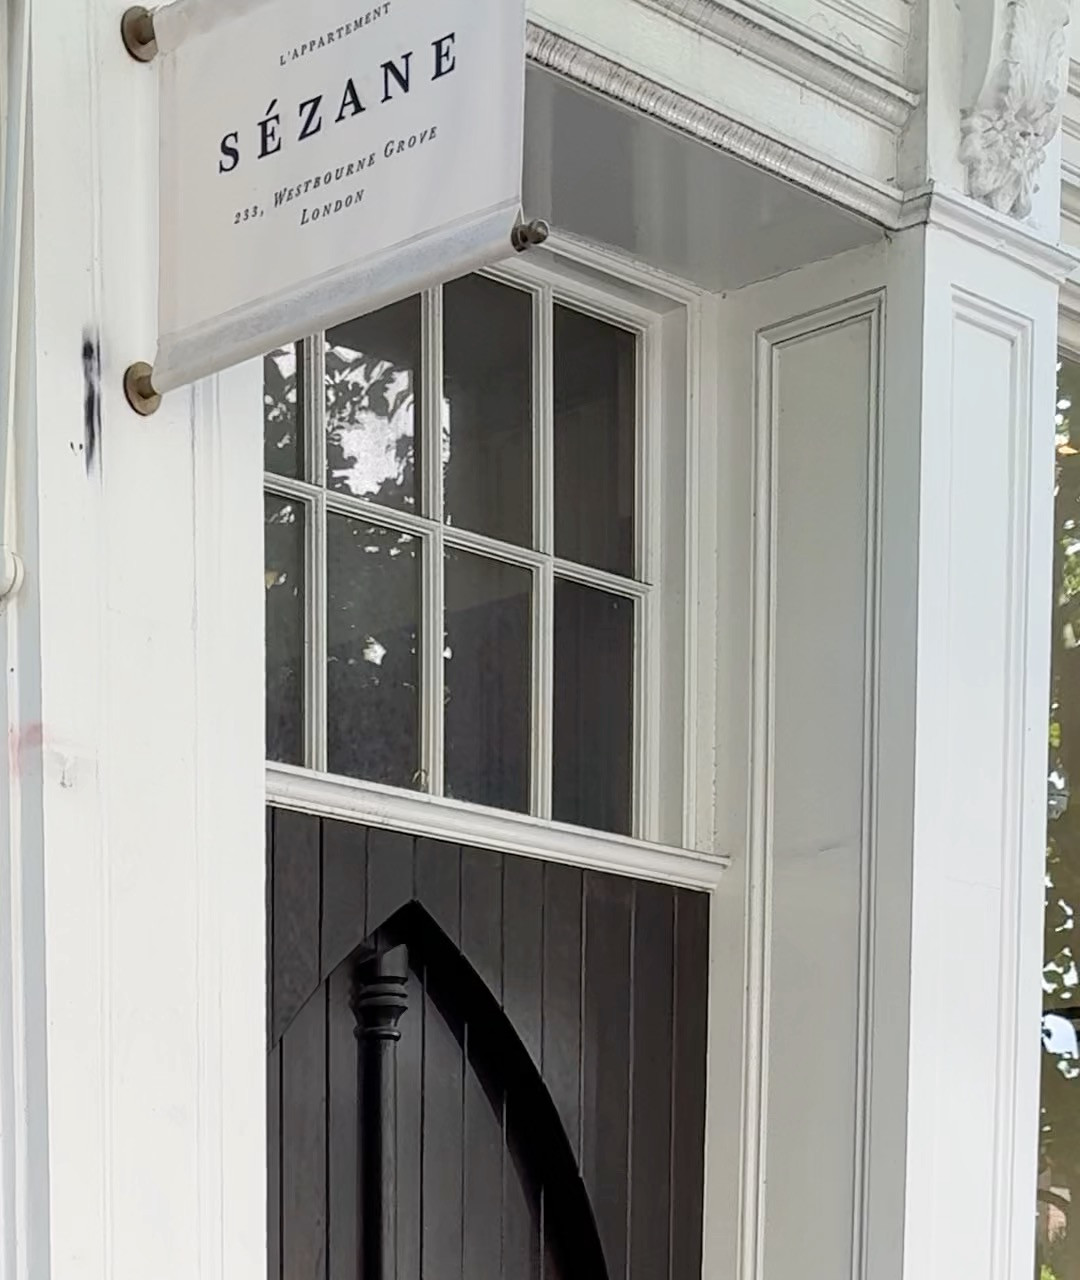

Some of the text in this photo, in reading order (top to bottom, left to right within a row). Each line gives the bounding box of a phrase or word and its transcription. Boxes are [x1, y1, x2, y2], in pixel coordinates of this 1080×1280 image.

[279, 1, 391, 66] L'APPARTEMENT
[218, 31, 457, 174] SÉZANE
[233, 126, 438, 225] 233, WESTBOURNE GROVE
[300, 188, 365, 226] LONDON
